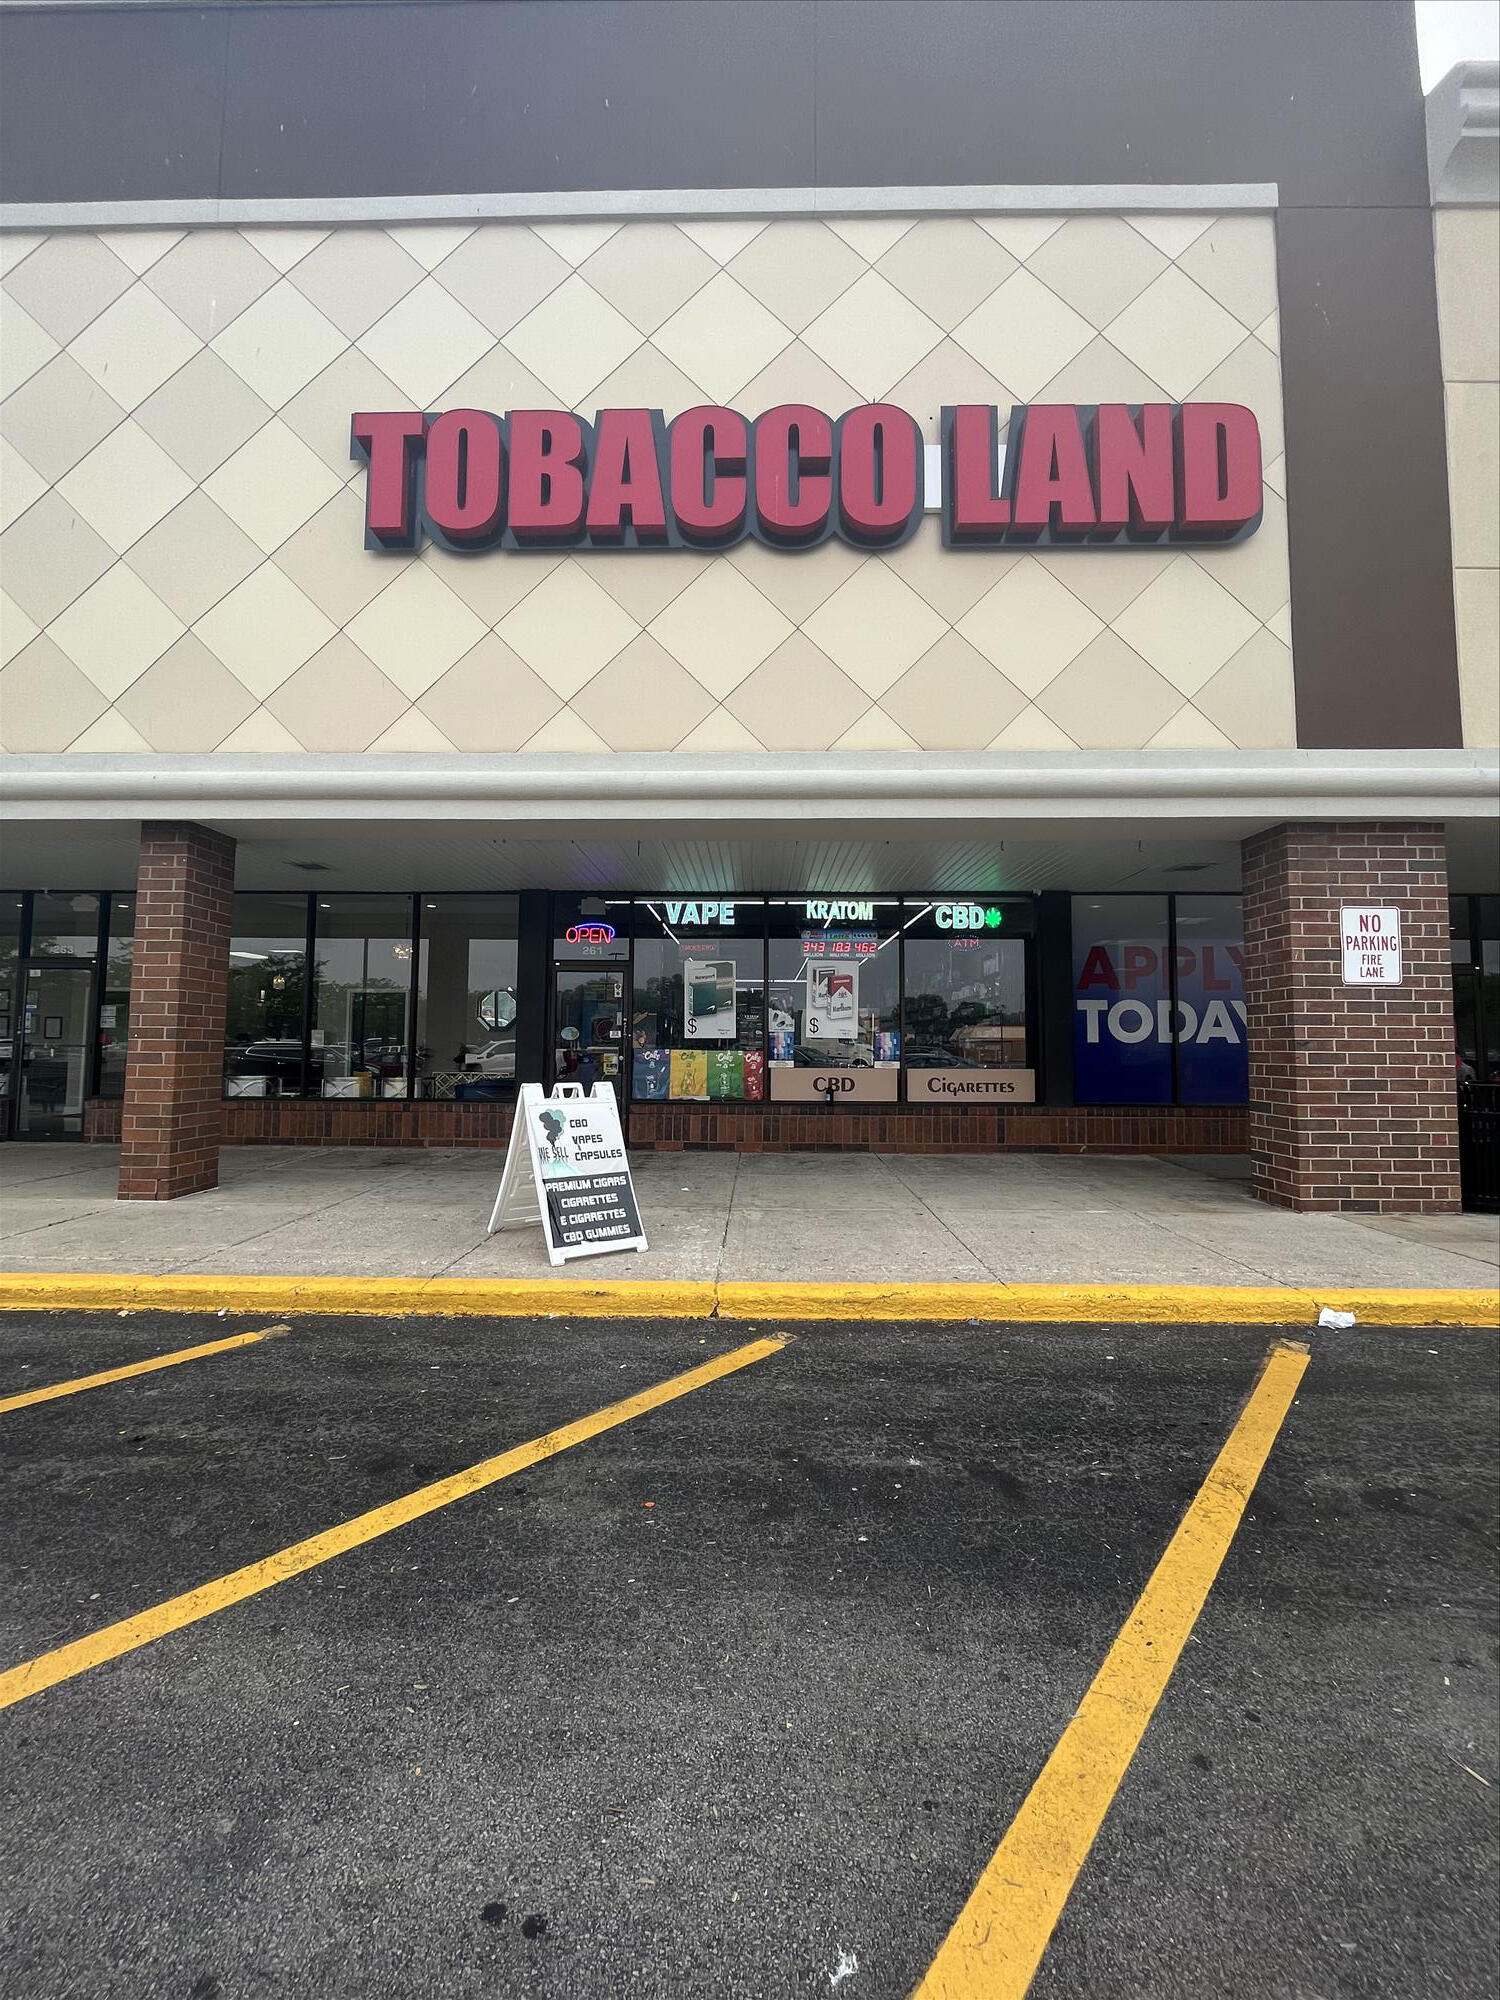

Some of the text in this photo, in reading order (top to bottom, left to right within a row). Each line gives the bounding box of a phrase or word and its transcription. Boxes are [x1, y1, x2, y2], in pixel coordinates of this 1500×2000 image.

[352, 402, 1263, 552] TOBACCO LAND
[666, 902, 736, 926] VAPE
[806, 900, 874, 921] KRATOM
[935, 904, 985, 929] CBD
[1359, 914, 1381, 933] NO
[566, 926, 612, 945] OPEN
[953, 939, 980, 948] ATM
[1346, 935, 1397, 952] PARKING
[582, 946, 602, 956] 261
[803, 941, 826, 952] 343
[854, 942, 877, 953] 462
[1361, 953, 1383, 965] FIRE
[1360, 966, 1385, 978] LANE
[812, 1077, 856, 1092] CBD
[569, 1119, 588, 1128] CBD
[572, 1134, 603, 1144] VAPES
[538, 1145, 569, 1160] WE SELL
[574, 1148, 623, 1161] CAPSULES
[545, 1175, 627, 1192] PREMIUM CIGARS
[561, 1193, 619, 1209] CIGARETTES
[560, 1208, 627, 1226] E CIGARETTES
[563, 1223, 631, 1243] CBD GUMMIES
